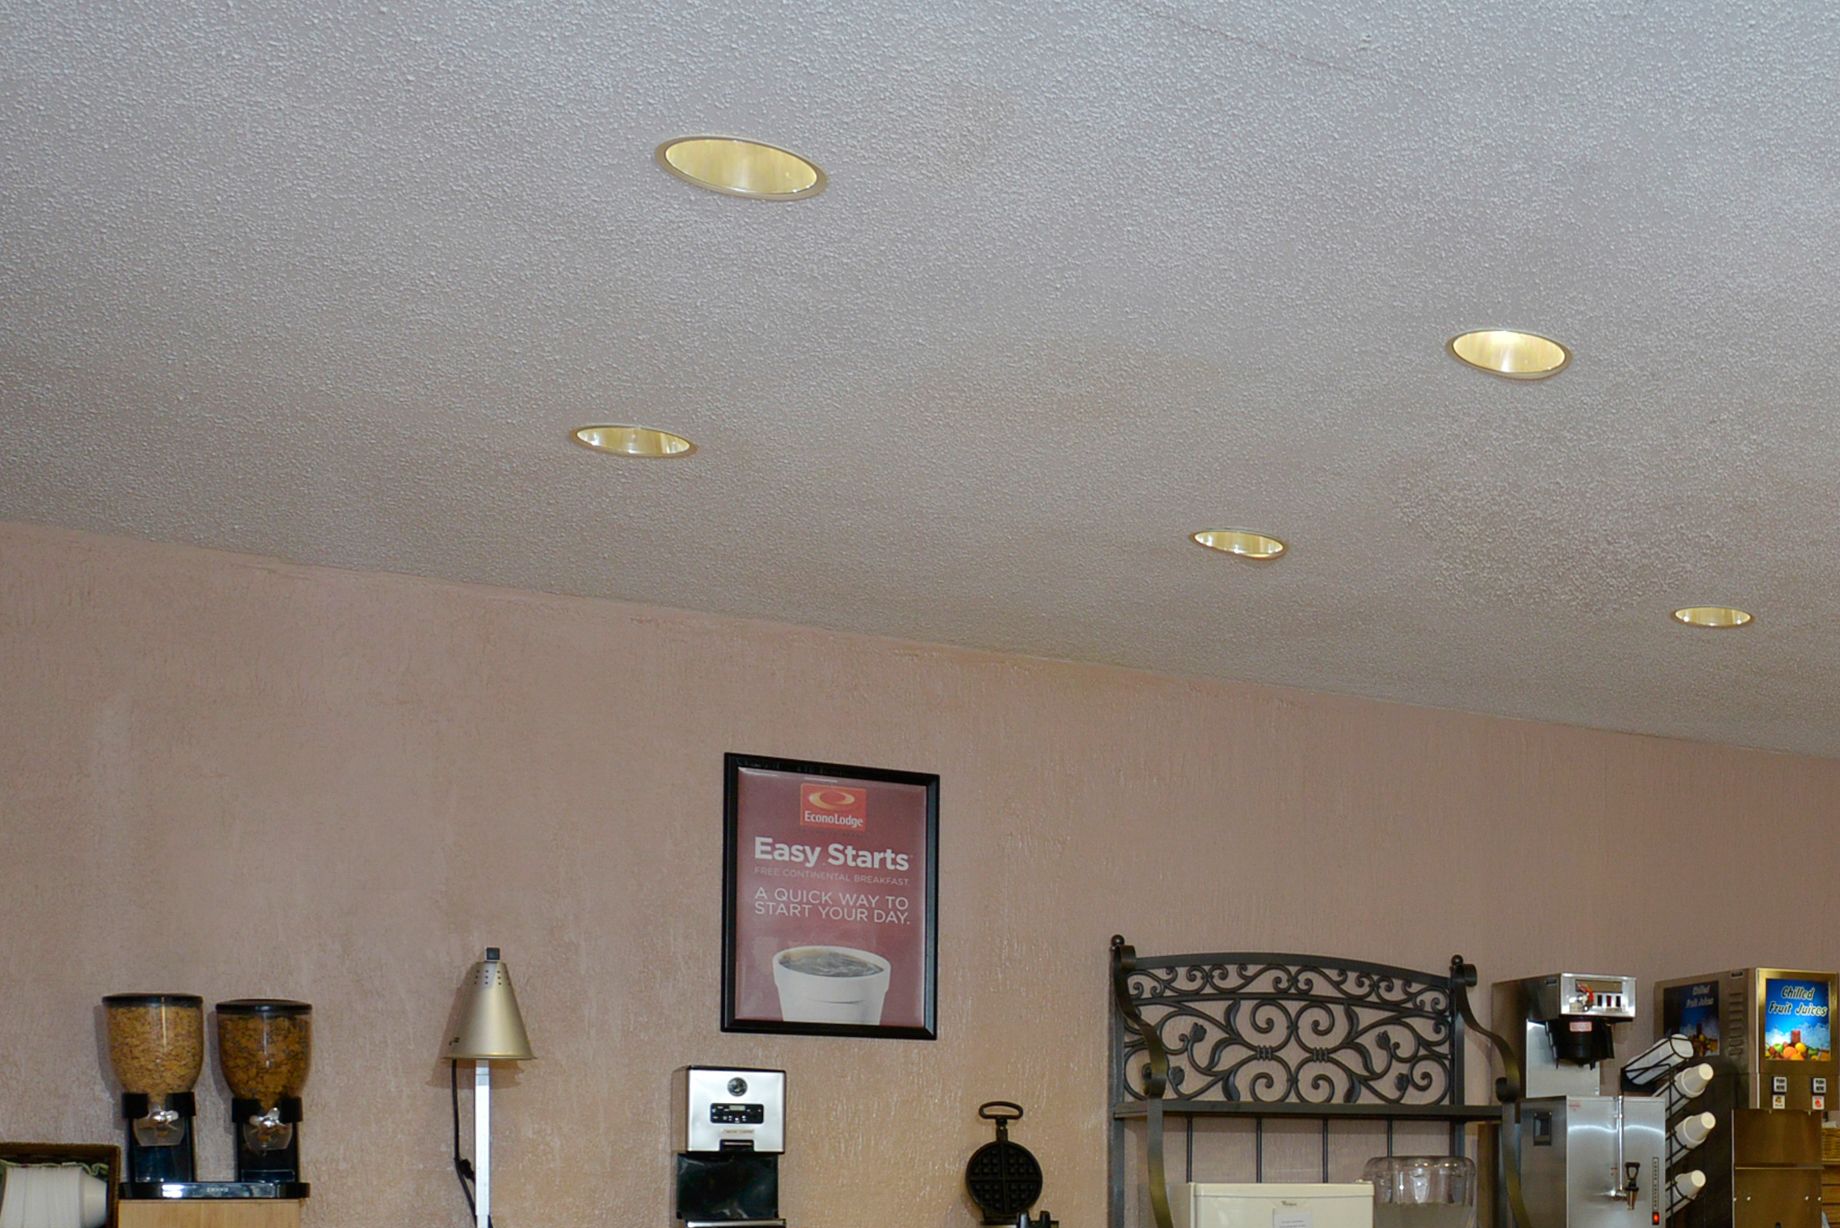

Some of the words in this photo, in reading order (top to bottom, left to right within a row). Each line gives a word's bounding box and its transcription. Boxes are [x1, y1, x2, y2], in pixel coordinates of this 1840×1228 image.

[754, 836, 821, 868] Easy
[828, 843, 910, 871] Starts
[754, 867, 778, 876] FREE
[782, 869, 850, 882] CONTINENTAL
[754, 887, 768, 900] A
[774, 888, 832, 905] QUICK
[839, 893, 880, 908] WAY
[885, 897, 909, 910] TO
[754, 901, 813, 917] START
[818, 906, 868, 922] YOUR
[874, 910, 911, 925] DAY.
[1781, 985, 1815, 1000] Chilled
[1768, 1002, 1792, 1015] Fruit
[1795, 1003, 1828, 1017] Juices
